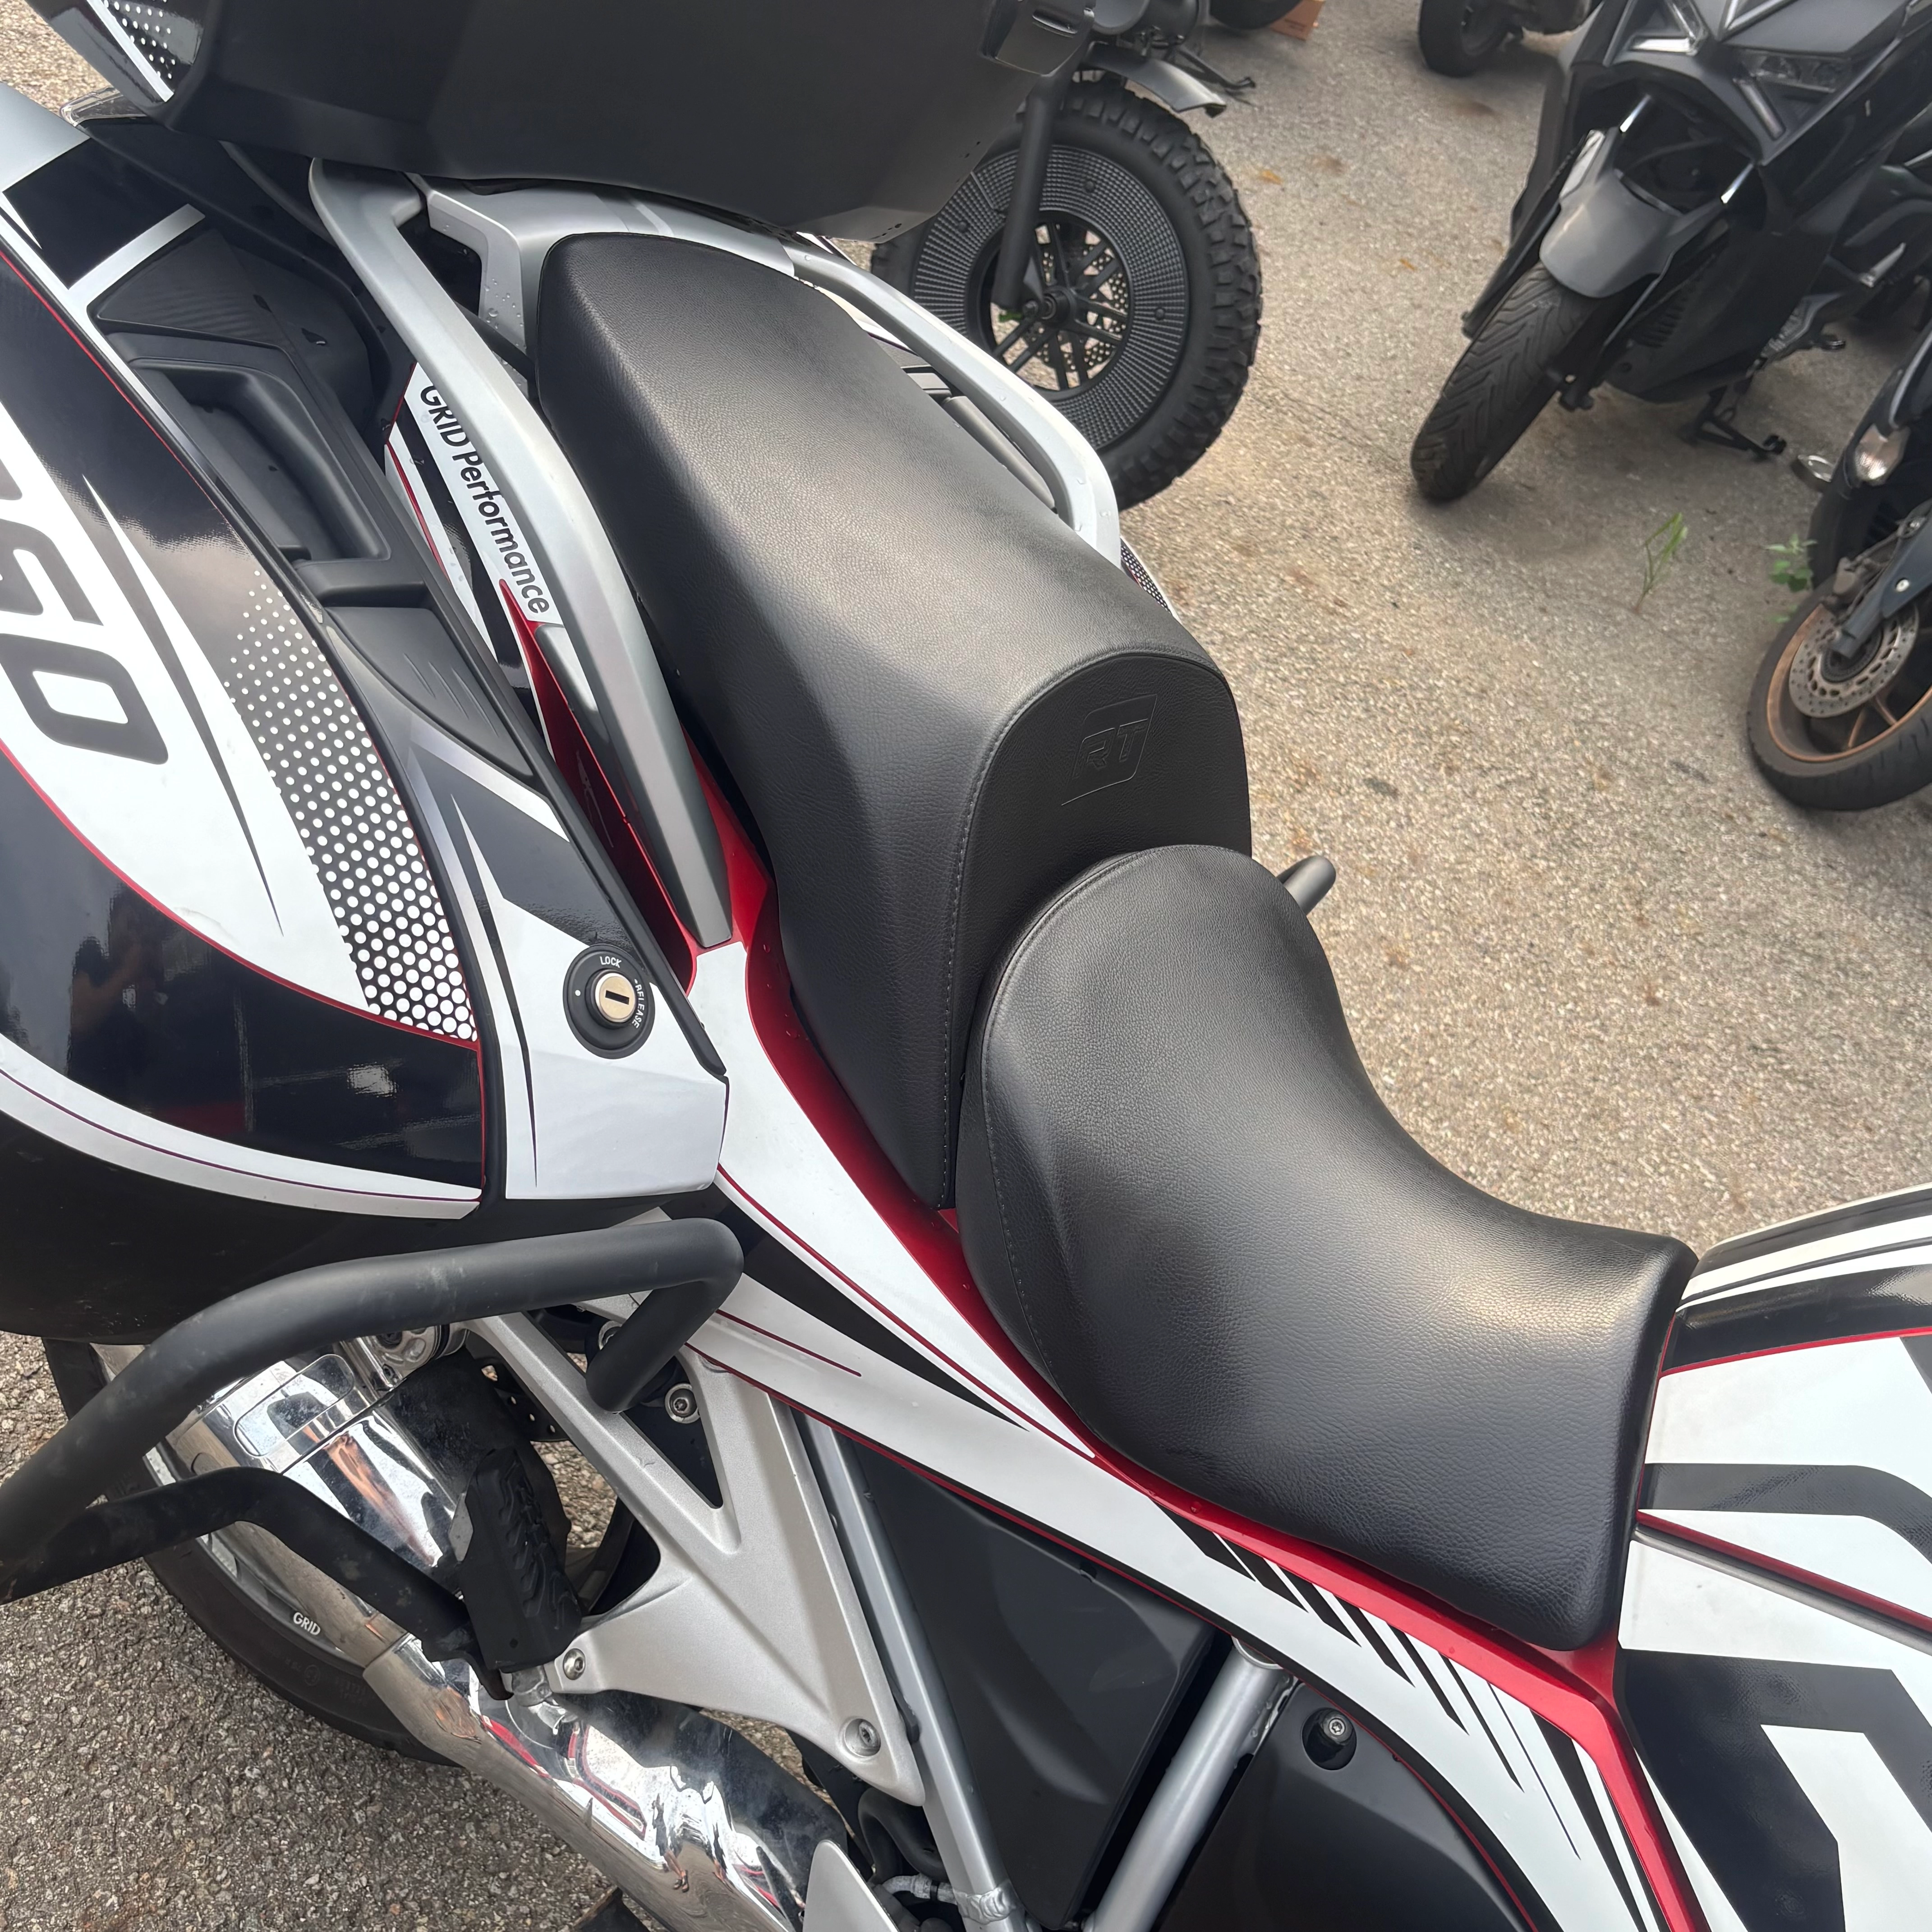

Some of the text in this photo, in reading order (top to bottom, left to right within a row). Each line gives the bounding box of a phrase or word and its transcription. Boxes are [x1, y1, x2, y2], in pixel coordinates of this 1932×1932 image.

[420, 385, 549, 614] GRID Performance
[599, 956, 622, 968] LOCK
[631, 984, 645, 1029] RELEASE
[293, 1612, 321, 1635] GRID
